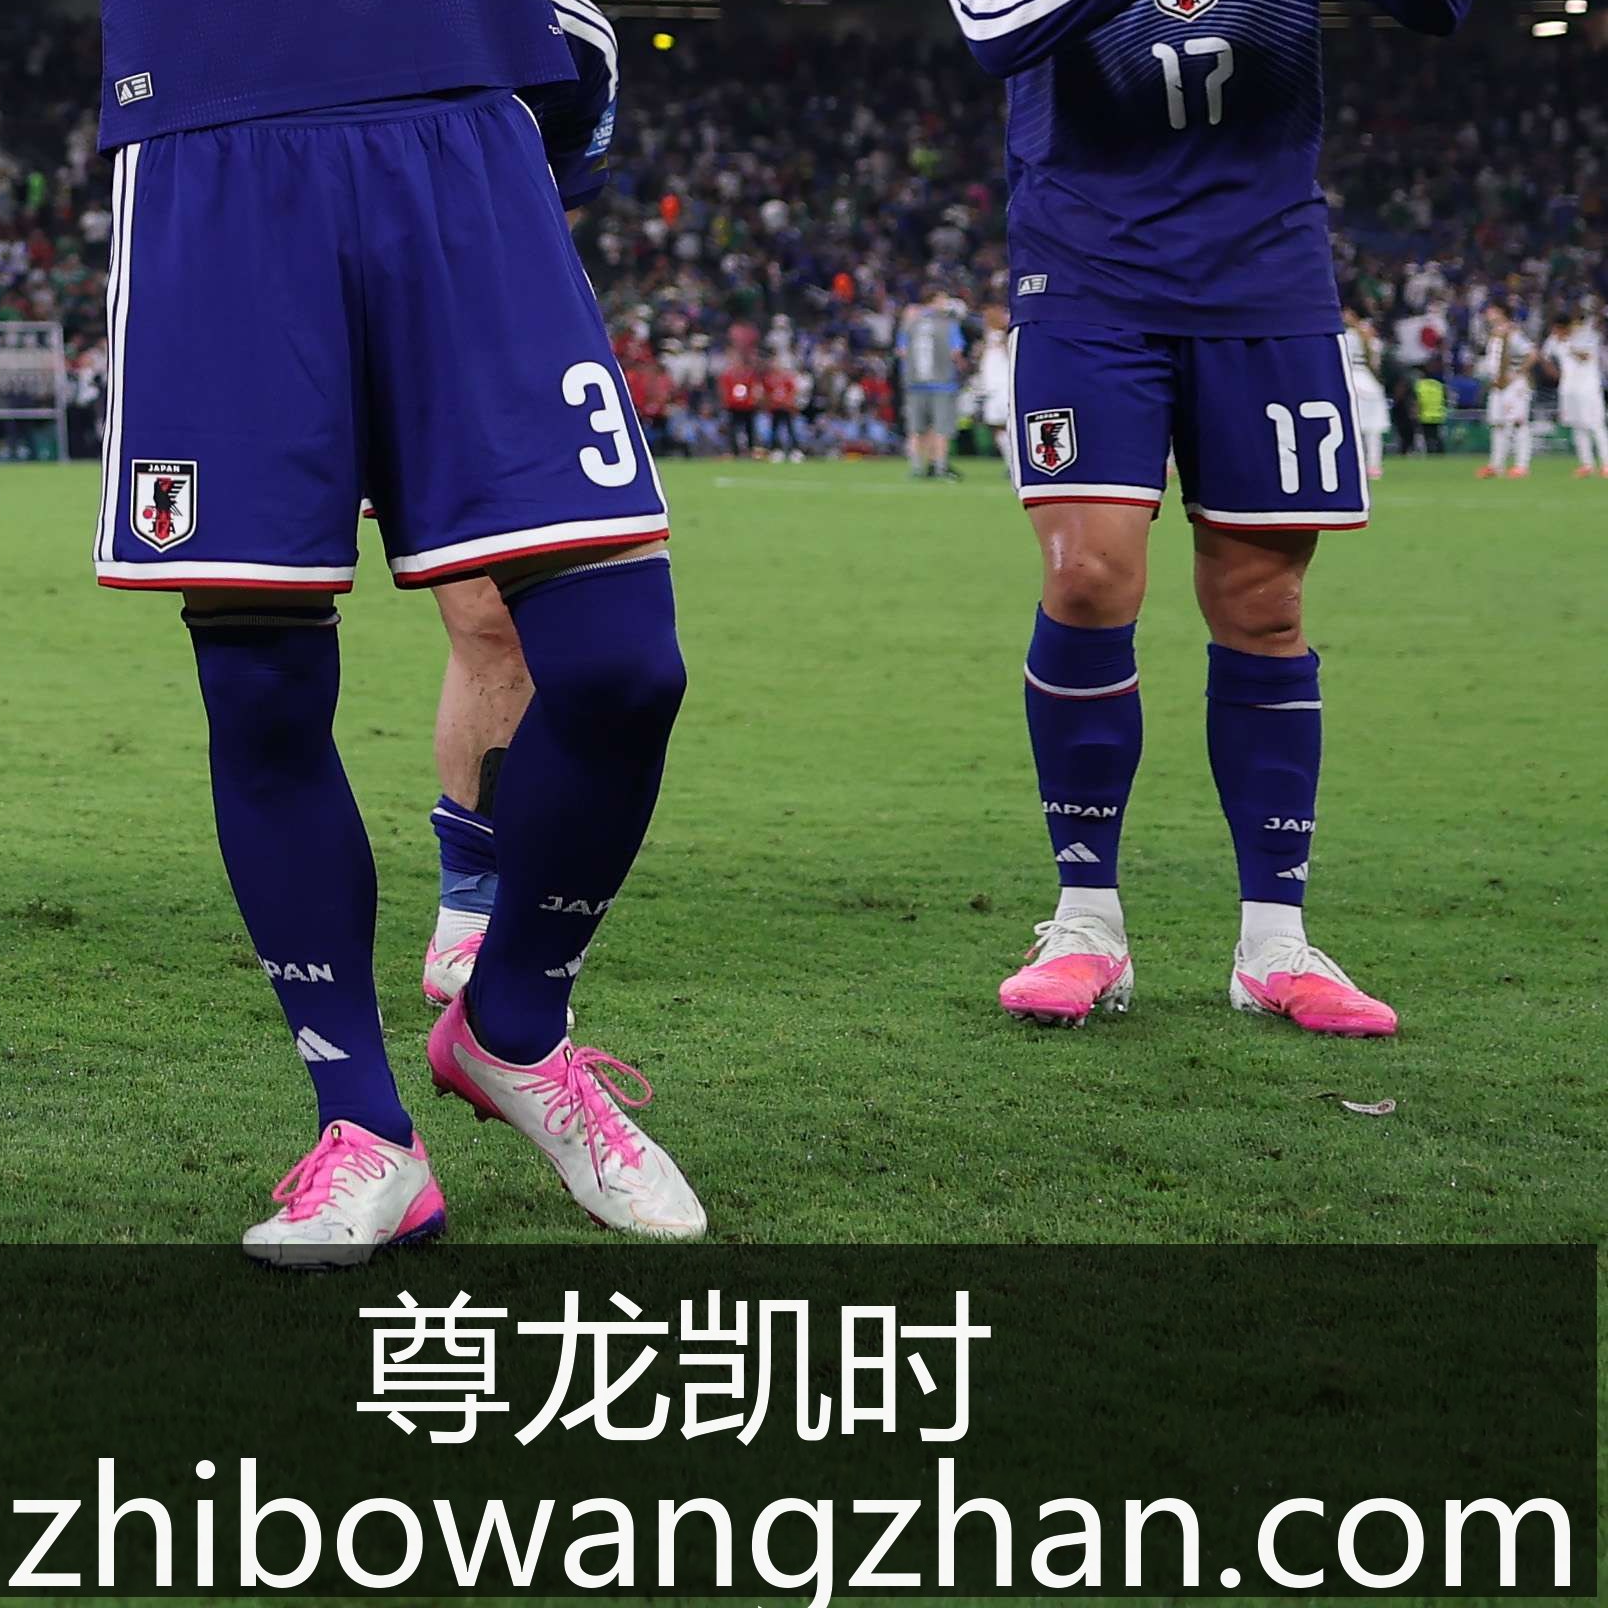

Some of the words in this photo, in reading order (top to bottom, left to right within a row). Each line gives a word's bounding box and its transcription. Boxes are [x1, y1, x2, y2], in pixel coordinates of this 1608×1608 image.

[1151, 36, 1234, 130] 17
[561, 361, 637, 488] 3
[1266, 401, 1344, 494] 17
[147, 463, 181, 473] JAPAN
[1263, 817, 1316, 833] JAP
[539, 895, 616, 916] JAP
[262, 960, 335, 983] PAN
